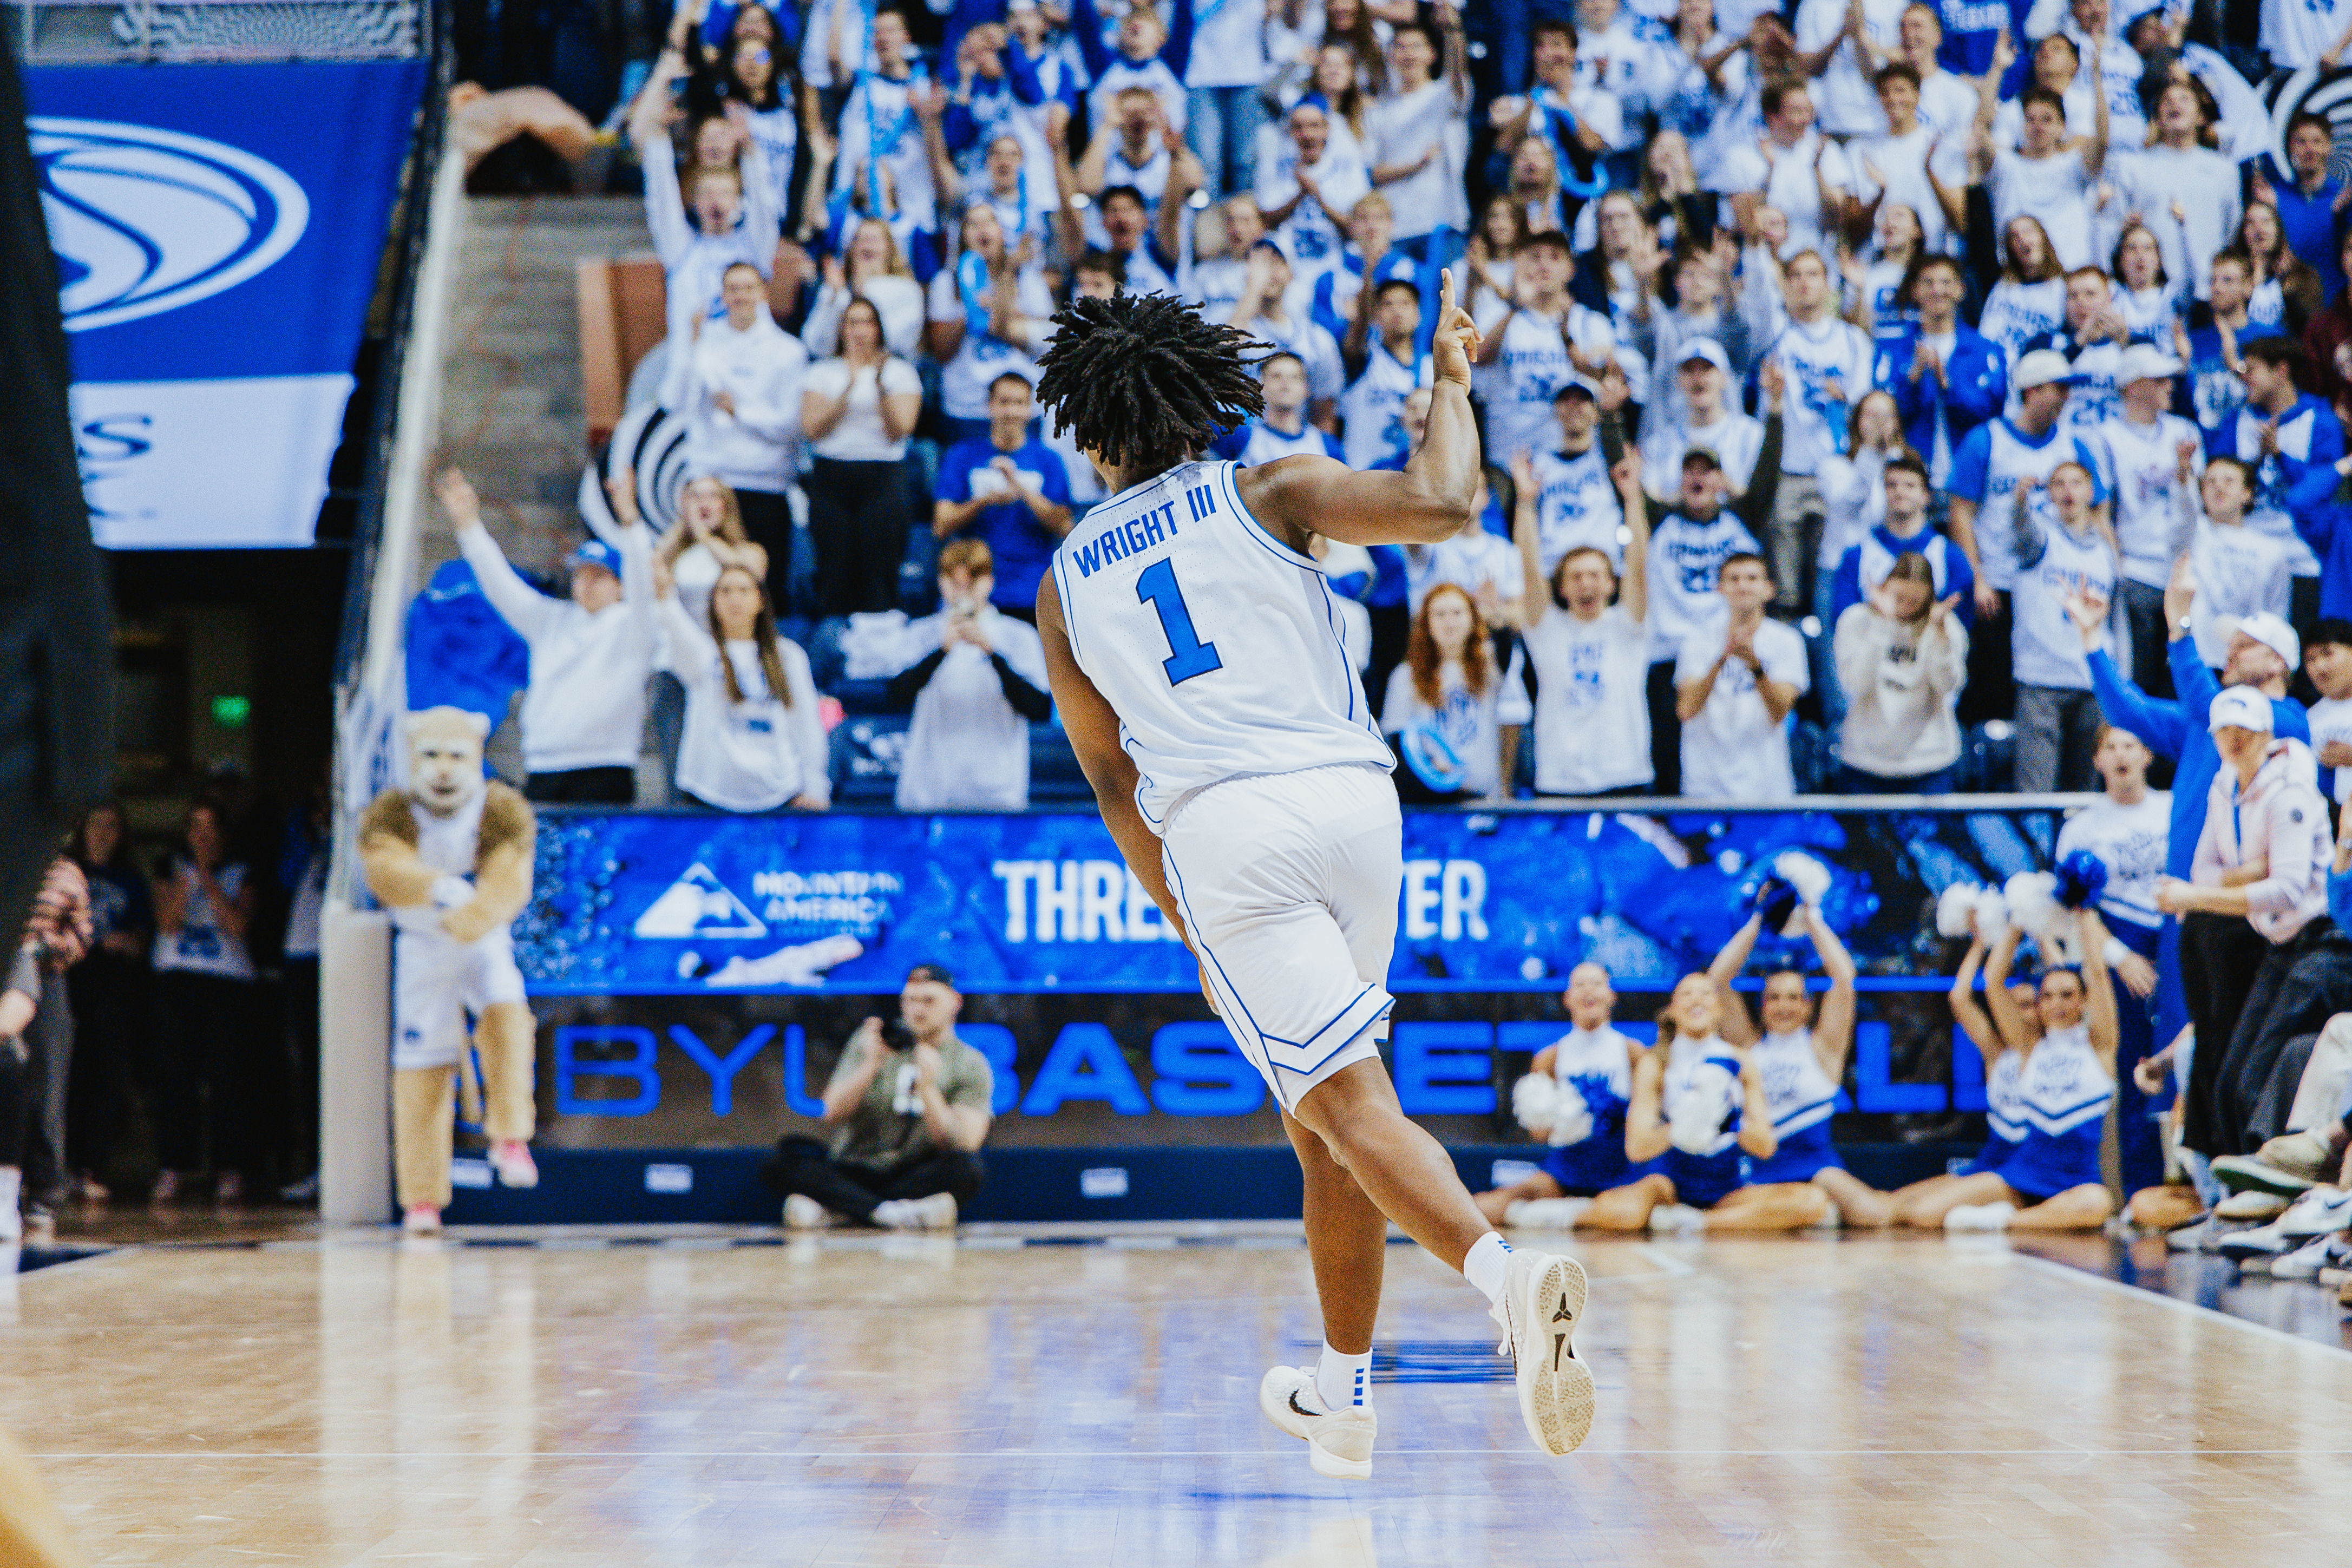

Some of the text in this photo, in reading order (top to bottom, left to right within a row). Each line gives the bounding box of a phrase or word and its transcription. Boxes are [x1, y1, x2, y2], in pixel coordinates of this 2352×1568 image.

[1072, 484, 1217, 578] WRIGHT III
[1135, 556, 1223, 687] 1
[993, 860, 1183, 943] THRE
